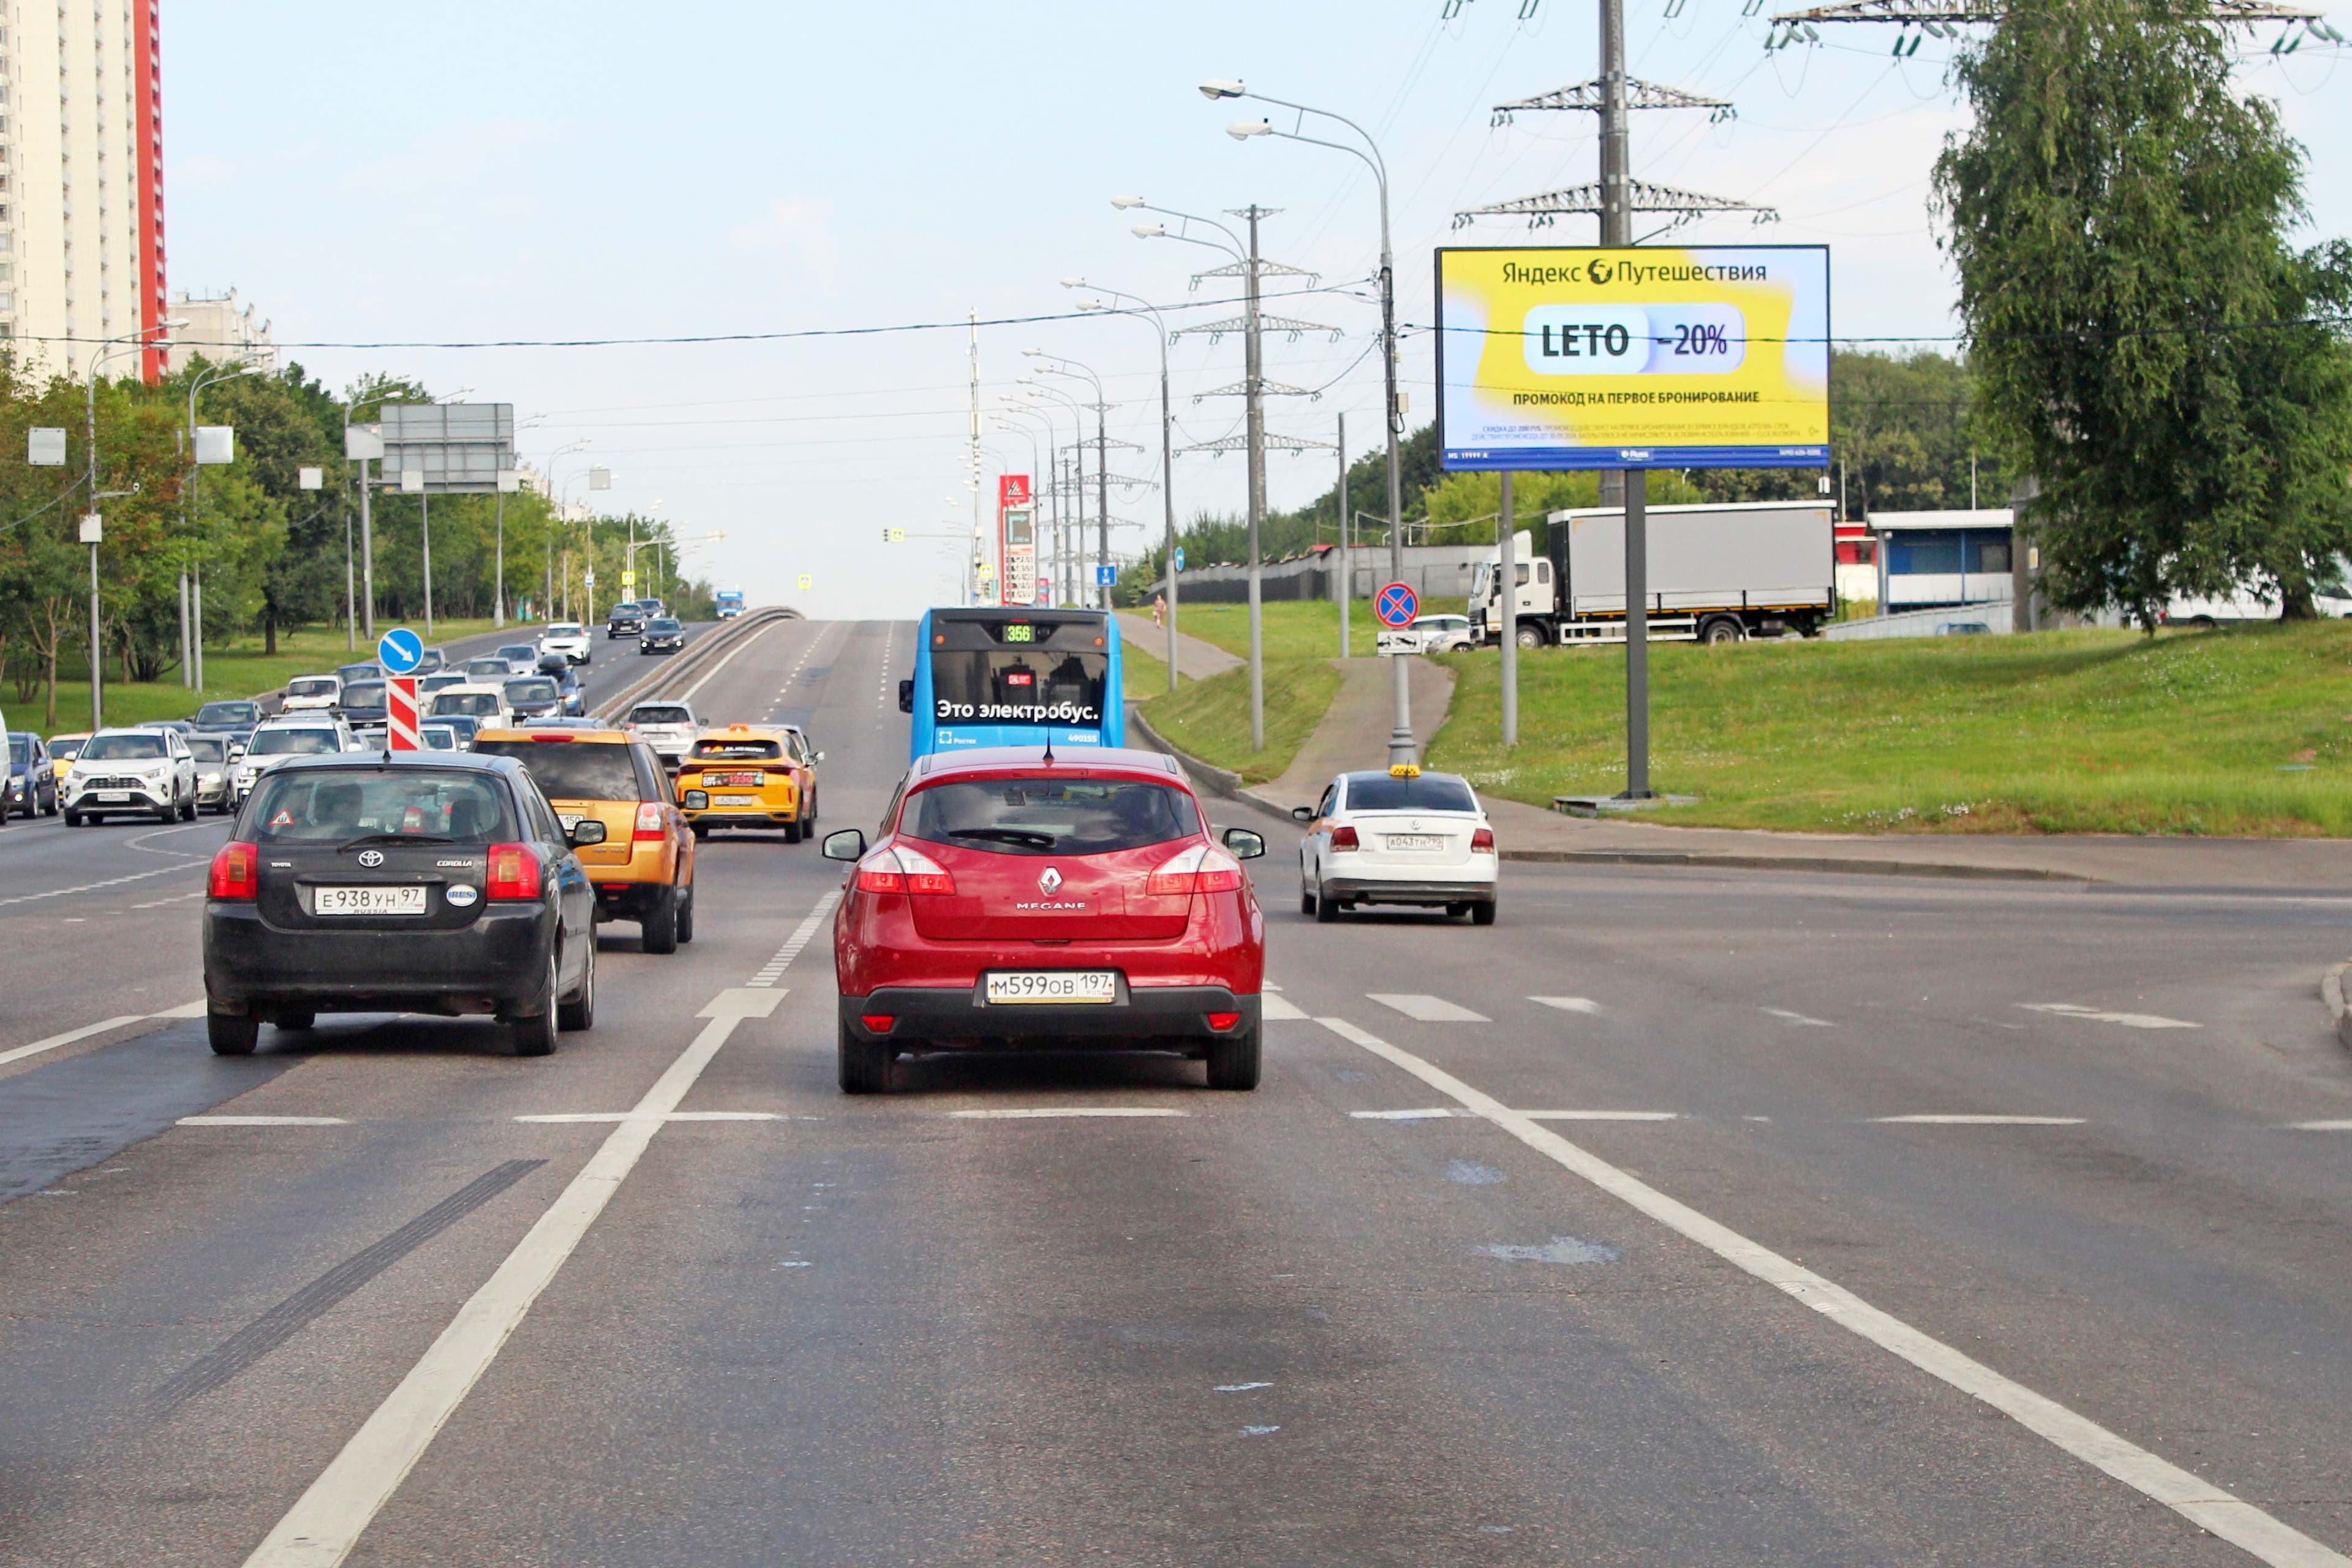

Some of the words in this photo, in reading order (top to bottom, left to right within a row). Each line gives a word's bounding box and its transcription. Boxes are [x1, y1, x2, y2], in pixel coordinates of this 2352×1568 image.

[1502, 262, 1581, 285] Яндекс
[1618, 261, 1766, 285] Путешествия
[1542, 324, 1629, 356] LETO
[1513, 393, 1586, 406] ПРОМОКОД
[1588, 393, 1605, 404] НА
[1608, 392, 1656, 404] ПЕРВОЕ
[1658, 391, 1760, 404] БРОНИРОВАНИЕ
[1008, 625, 1031, 642] 356
[937, 699, 974, 718] Это
[979, 700, 1099, 723] электробус.
[401, 889, 419, 902] 97
[1080, 974, 1109, 989] 197
